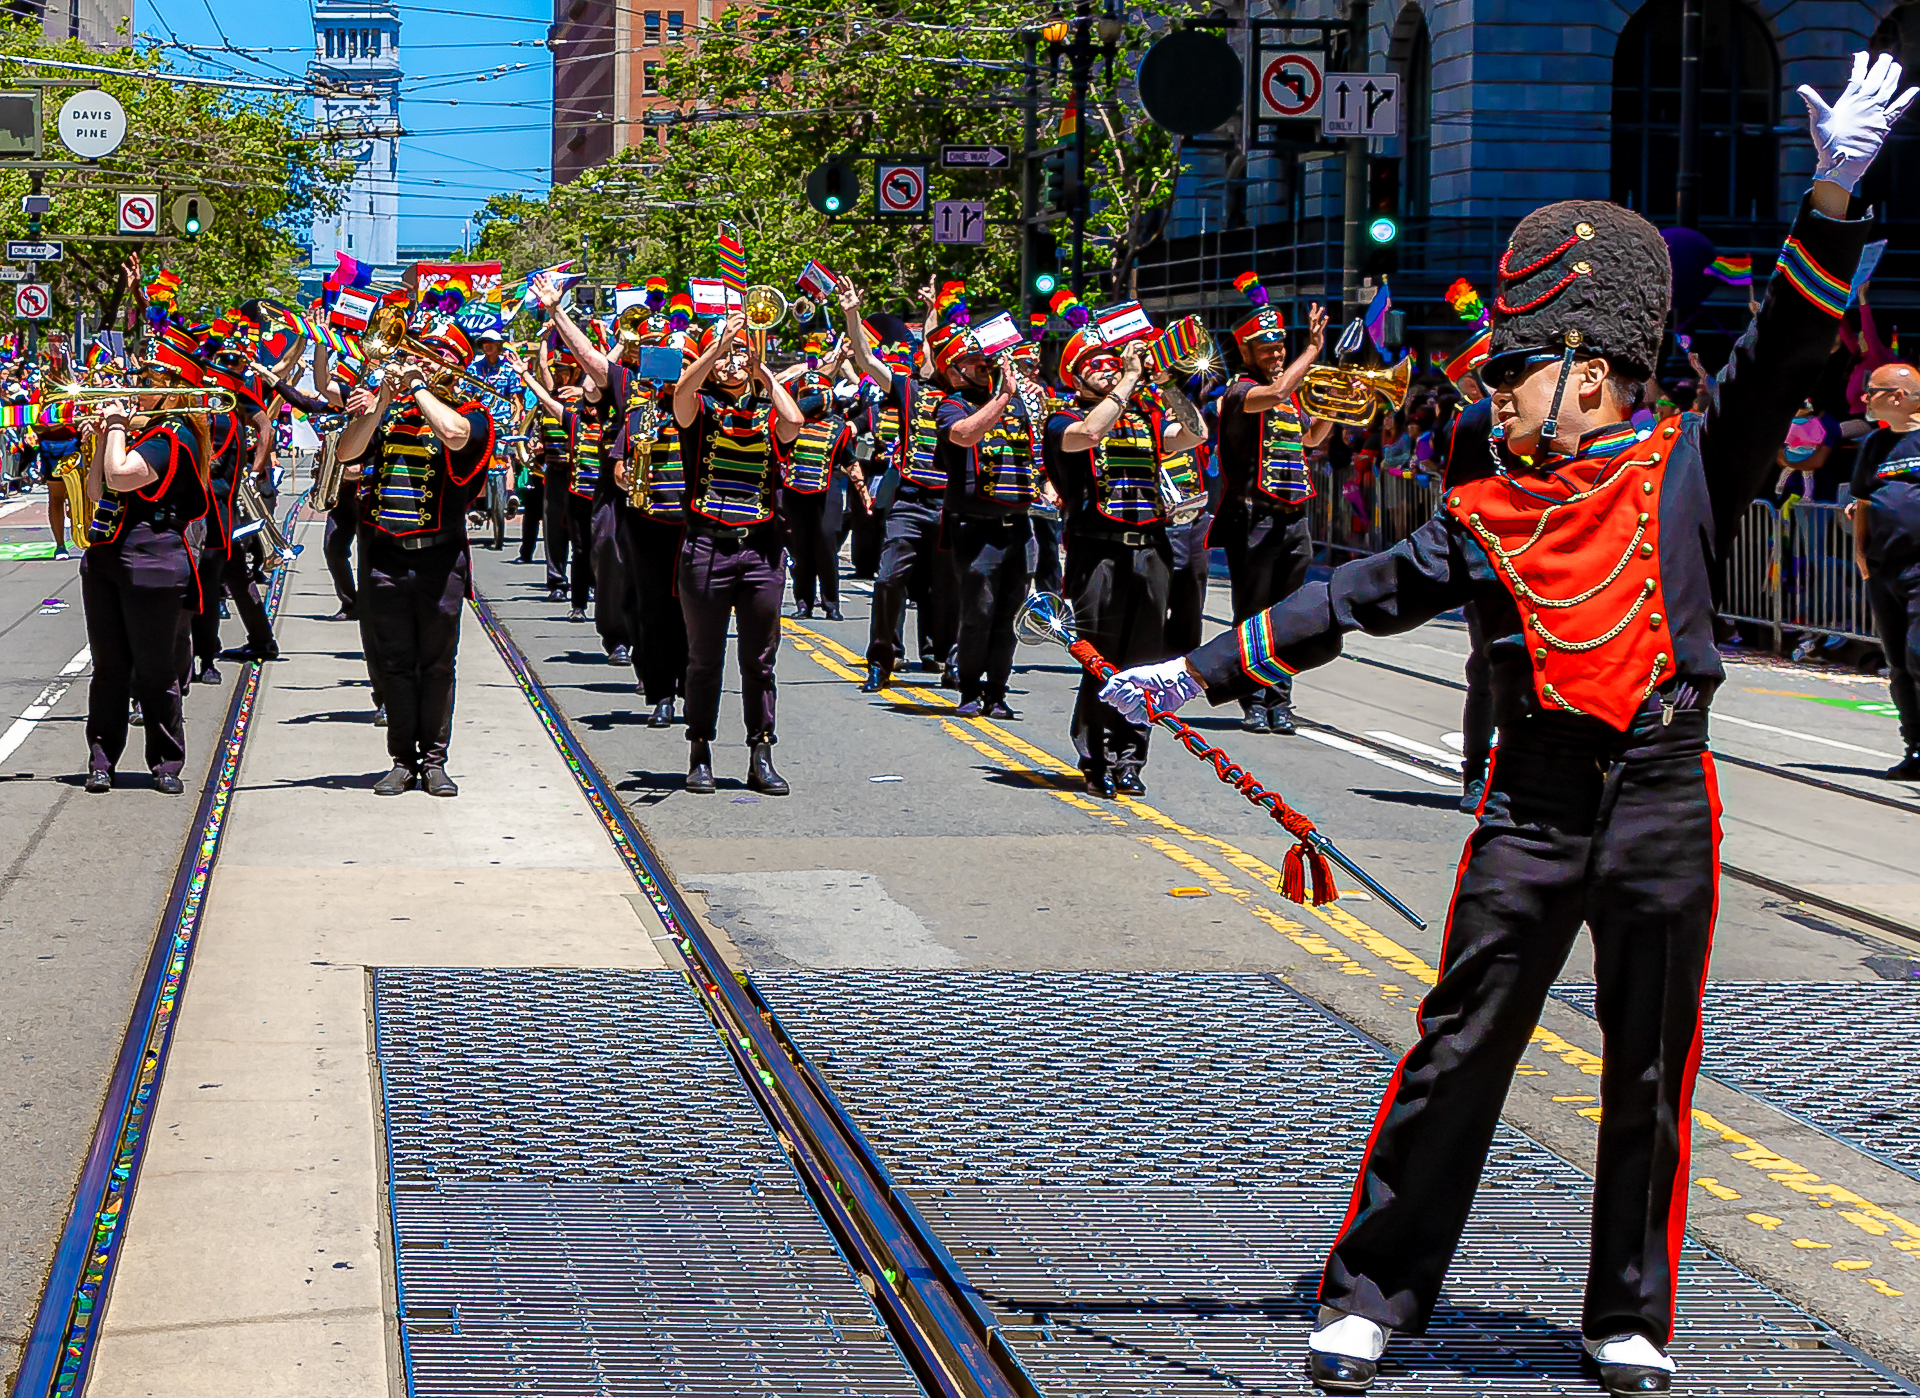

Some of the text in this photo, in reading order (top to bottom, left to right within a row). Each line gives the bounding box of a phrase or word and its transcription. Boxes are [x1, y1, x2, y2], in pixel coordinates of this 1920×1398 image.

[73, 110, 111, 120] DAVIS
[1329, 121, 1353, 131] ONLY
[76, 128, 107, 138] PINE
[950, 152, 988, 161] ONE WAY
